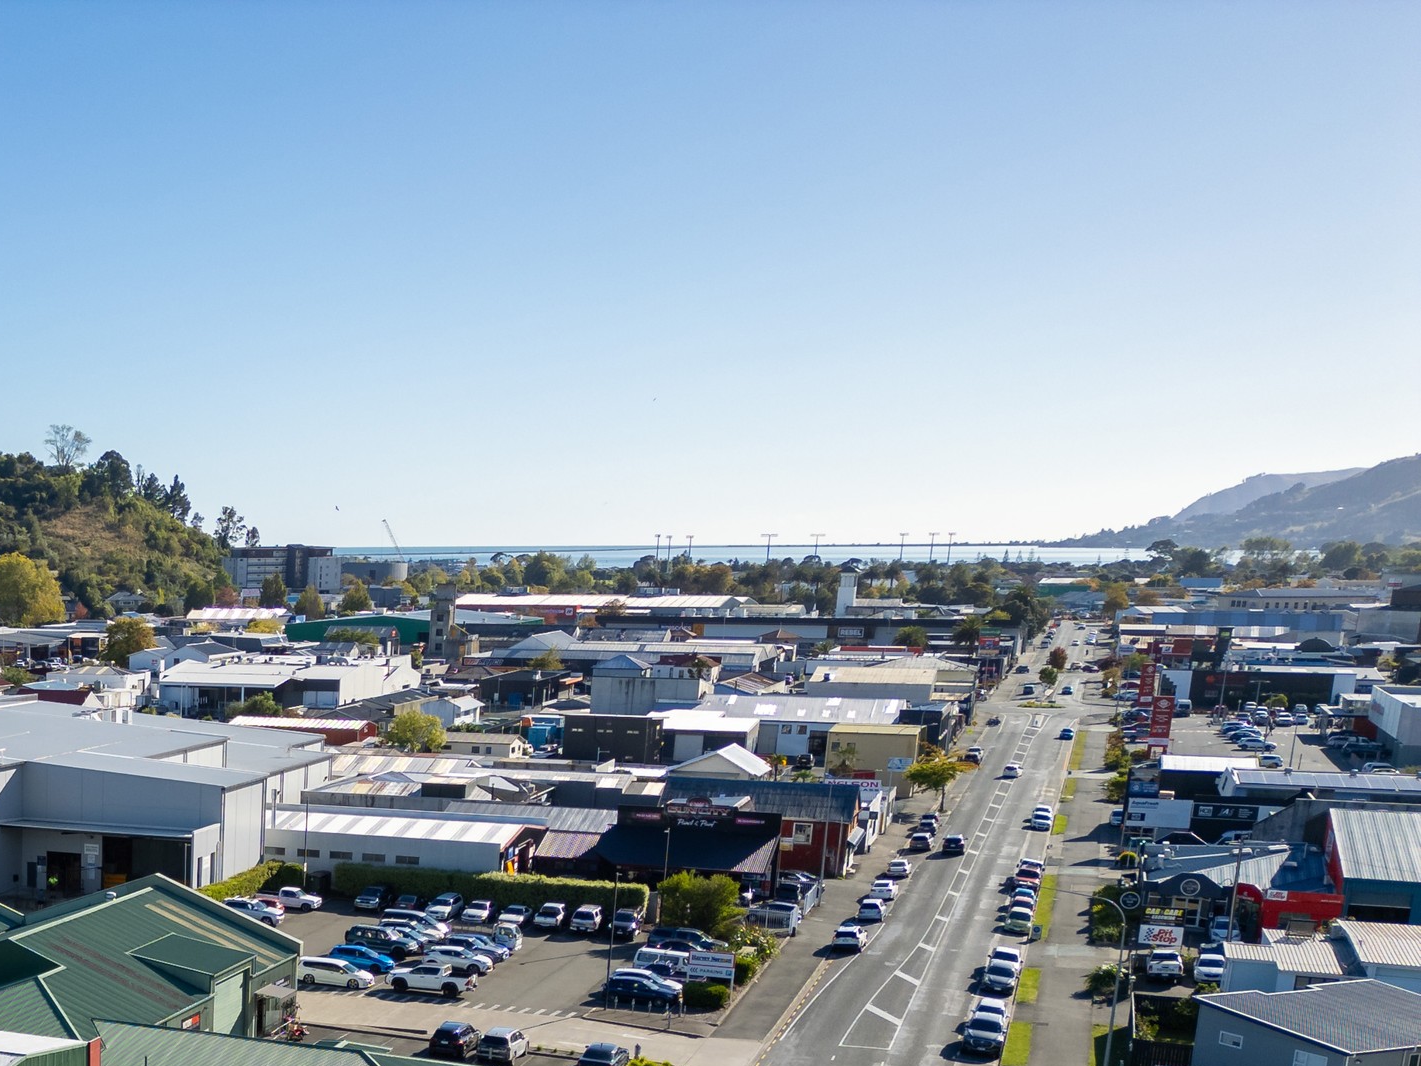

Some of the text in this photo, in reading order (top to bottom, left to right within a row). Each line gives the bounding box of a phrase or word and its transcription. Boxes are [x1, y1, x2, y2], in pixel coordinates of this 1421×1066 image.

[1158, 928, 1173, 938] Pit
[1152, 934, 1178, 944] Stop
[692, 954, 710, 962] Harvey
